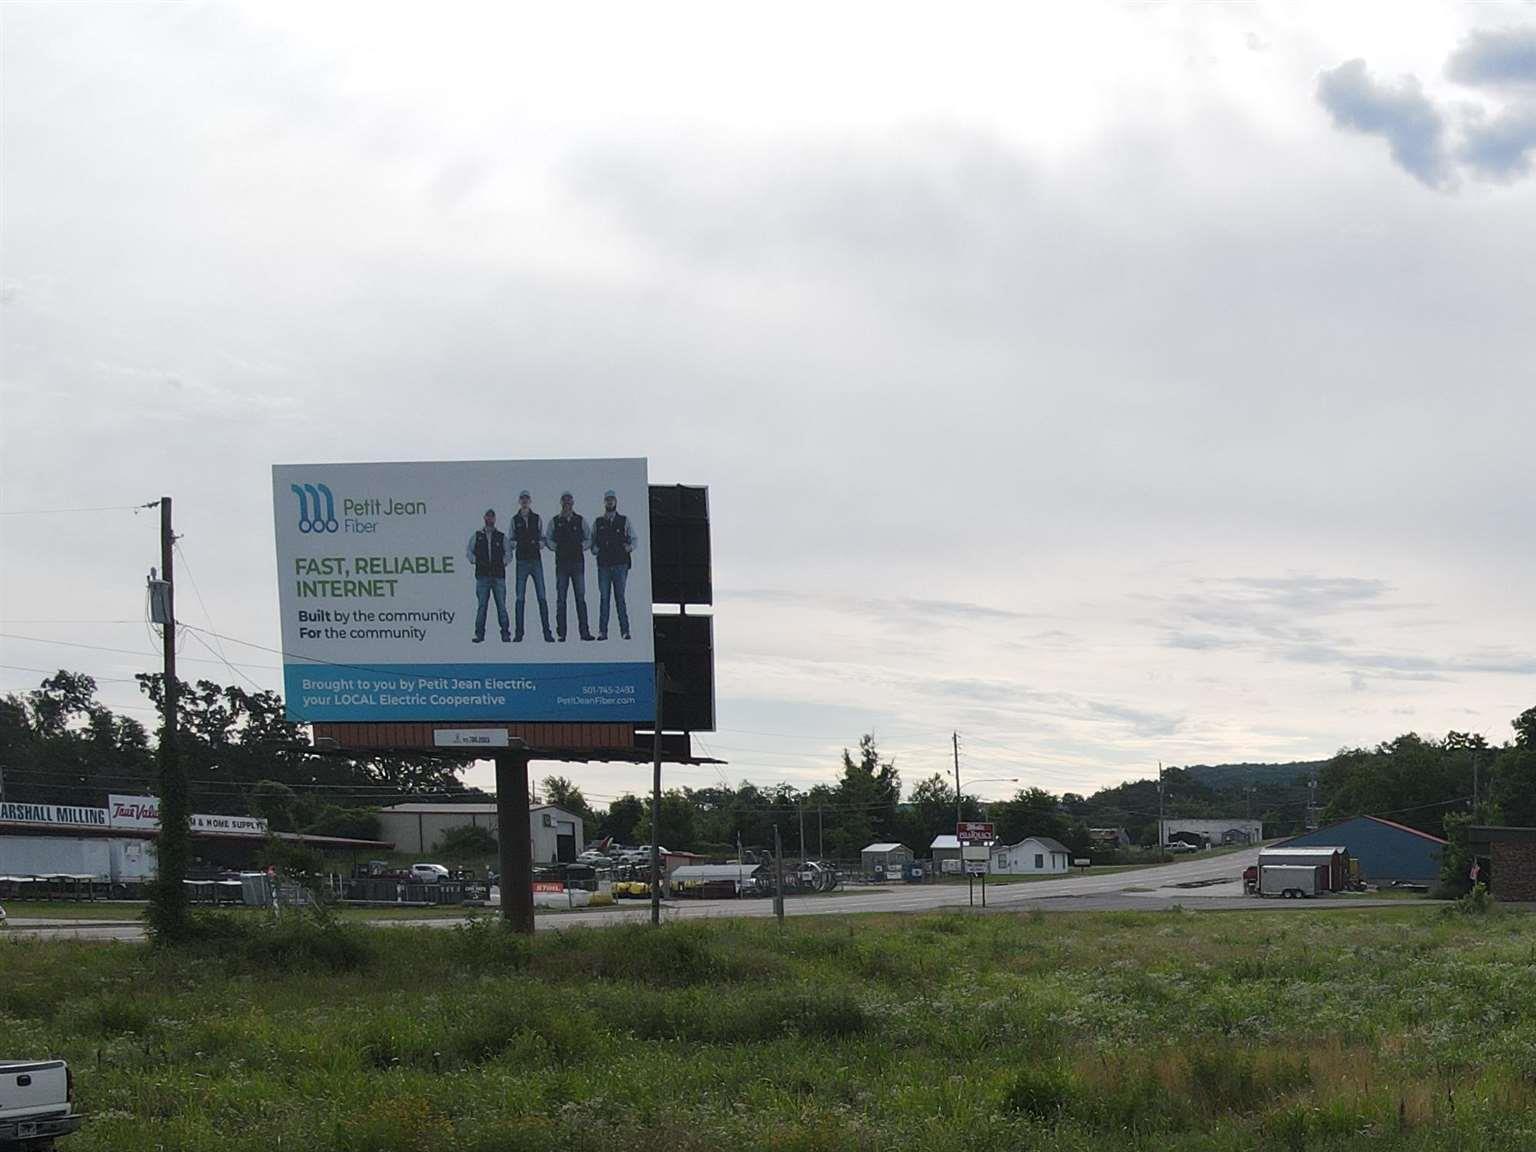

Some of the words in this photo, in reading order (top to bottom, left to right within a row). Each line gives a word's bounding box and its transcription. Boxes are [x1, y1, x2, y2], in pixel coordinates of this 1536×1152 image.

[343, 499, 382, 516] Petit
[384, 499, 427, 516] Jean
[344, 519, 378, 533] Fiber
[295, 557, 350, 578] FAST,
[355, 556, 455, 575] RELIABLE
[296, 579, 398, 598] INTERNET
[298, 610, 331, 623] Built
[334, 610, 350, 625] by
[353, 610, 375, 622] the
[378, 609, 455, 625] community
[299, 627, 322, 639] For
[325, 627, 347, 639] the
[349, 626, 427, 641] community
[302, 679, 353, 692] Brought
[357, 679, 370, 690] to
[374, 681, 396, 692] you
[400, 679, 415, 692] by
[418, 679, 448, 690] Petit
[451, 679, 481, 690] Jean
[485, 677, 536, 691] Electric,
[303, 695, 330, 708] your
[334, 695, 377, 705] LOCAL
[380, 693, 427, 705] Electric
[430, 693, 506, 708] Cooperative
[0, 803, 53, 822] ARSHALL
[56, 807, 105, 824] MILLING
[129, 804, 160, 820] Valu
